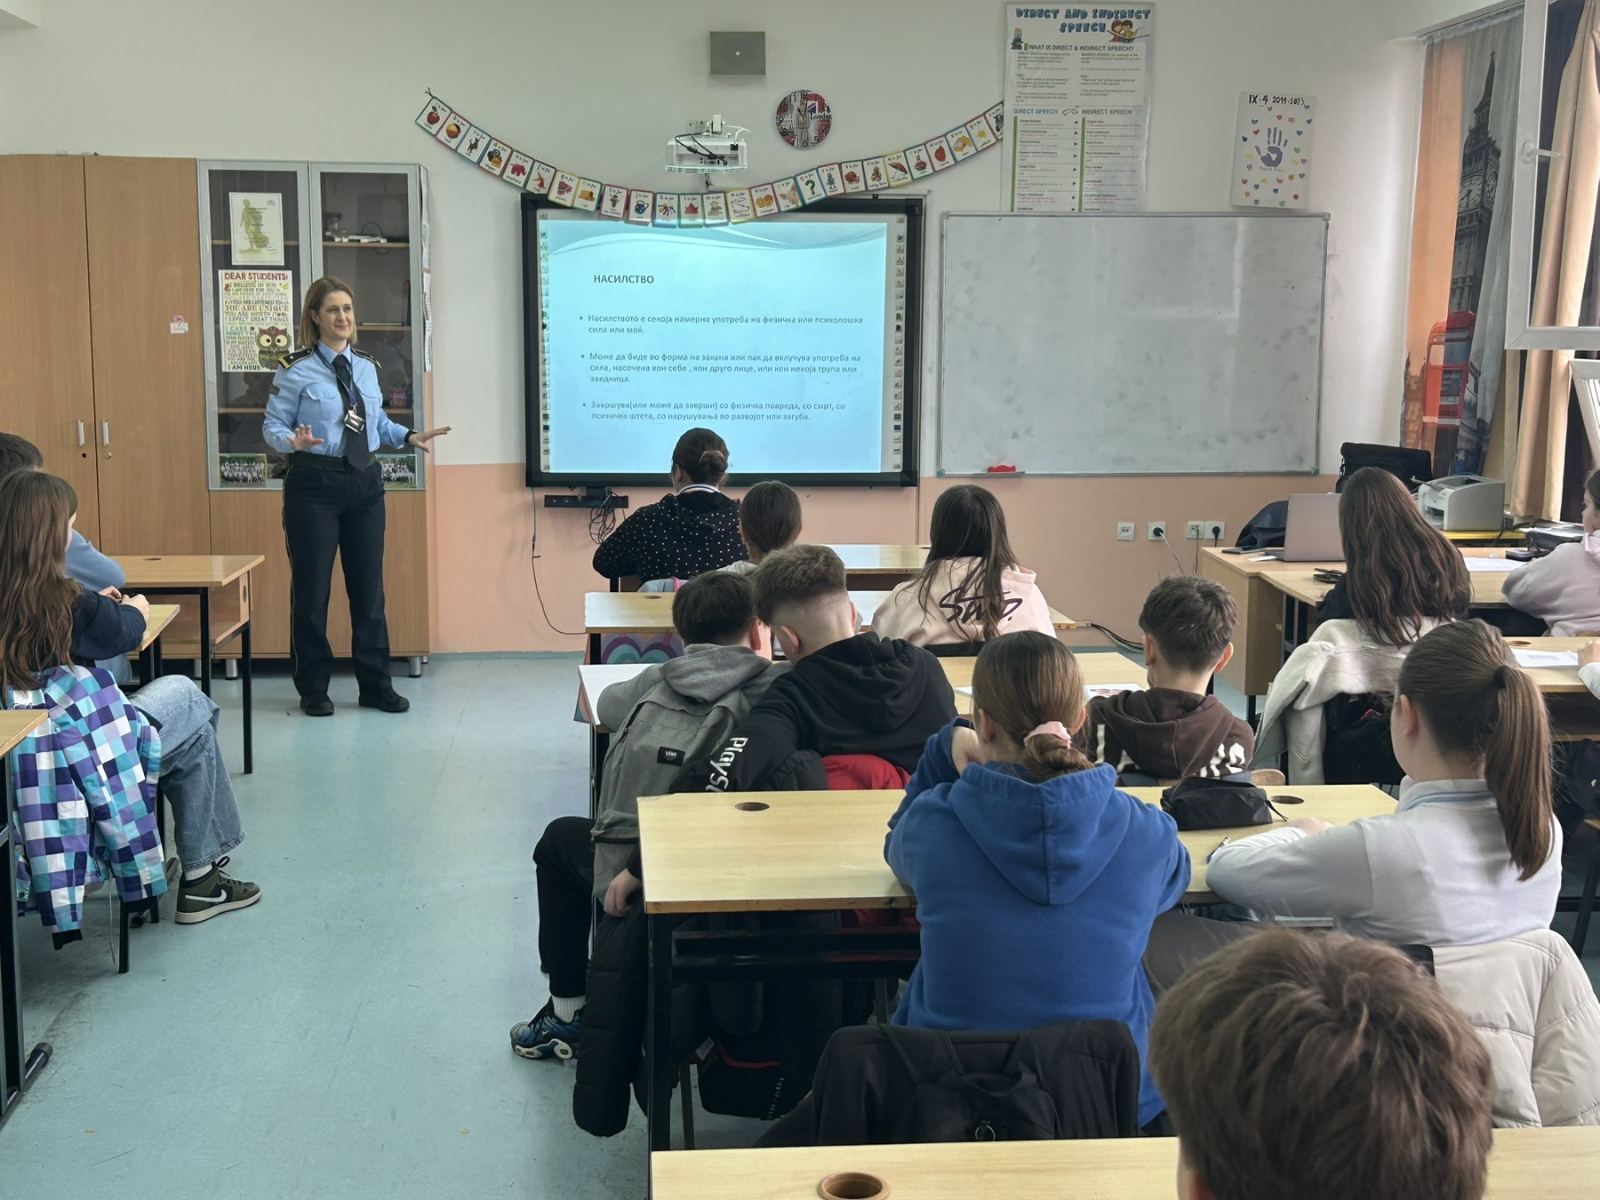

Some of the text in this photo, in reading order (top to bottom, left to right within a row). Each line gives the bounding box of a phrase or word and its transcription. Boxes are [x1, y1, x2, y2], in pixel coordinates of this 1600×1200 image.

[1015, 8, 1151, 20] DIRECT AND INDIRECT
[1059, 22, 1107, 33] SPEECH
[224, 272, 246, 280] DEAR
[593, 274, 655, 284] НАСИЛСТВО
[588, 314, 639, 323] Насилството
[647, 315, 673, 324] секоја
[674, 316, 710, 324] намерна
[712, 315, 749, 325] употреба
[762, 315, 796, 325] физичка
[589, 353, 614, 361] Може
[615, 354, 626, 362] да
[627, 353, 648, 362] биде
[661, 353, 688, 362] форма
[812, 353, 849, 363] употреба
[668, 364, 687, 372] себе
[790, 366, 817, 374] некоја
[730, 402, 763, 410] физичка
[731, 413, 765, 421] развојот
